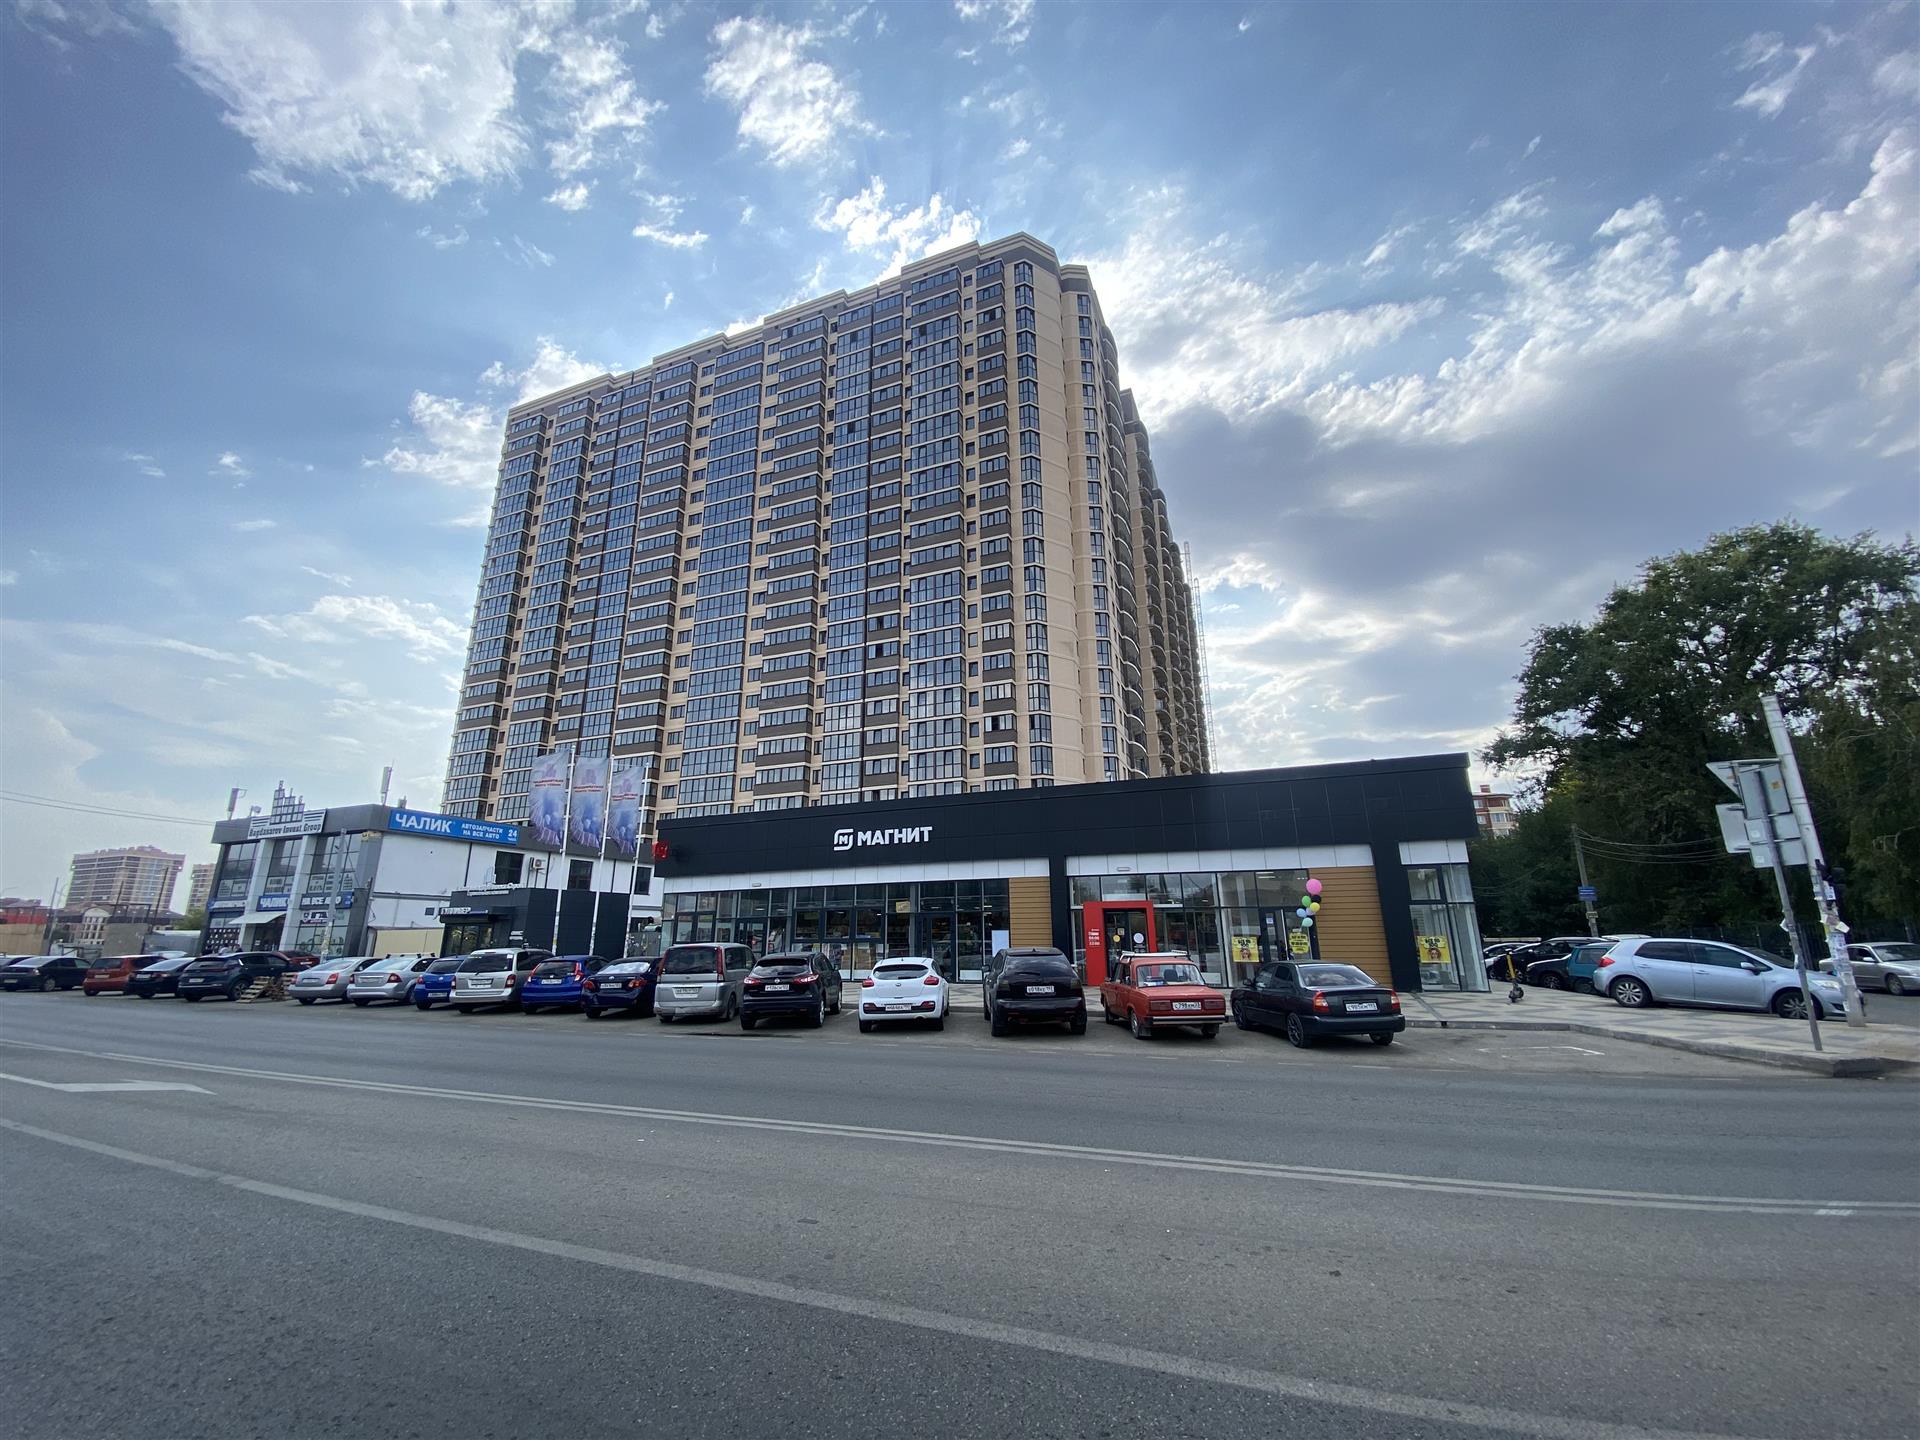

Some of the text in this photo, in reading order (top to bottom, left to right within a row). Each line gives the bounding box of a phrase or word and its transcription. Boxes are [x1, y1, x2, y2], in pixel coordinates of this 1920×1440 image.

[395, 813, 452, 833] ЧАЛИК
[461, 823, 503, 834] АВТОЗАПЧАСТИ
[508, 829, 517, 837] 24
[857, 826, 932, 846] МАГНИТ
